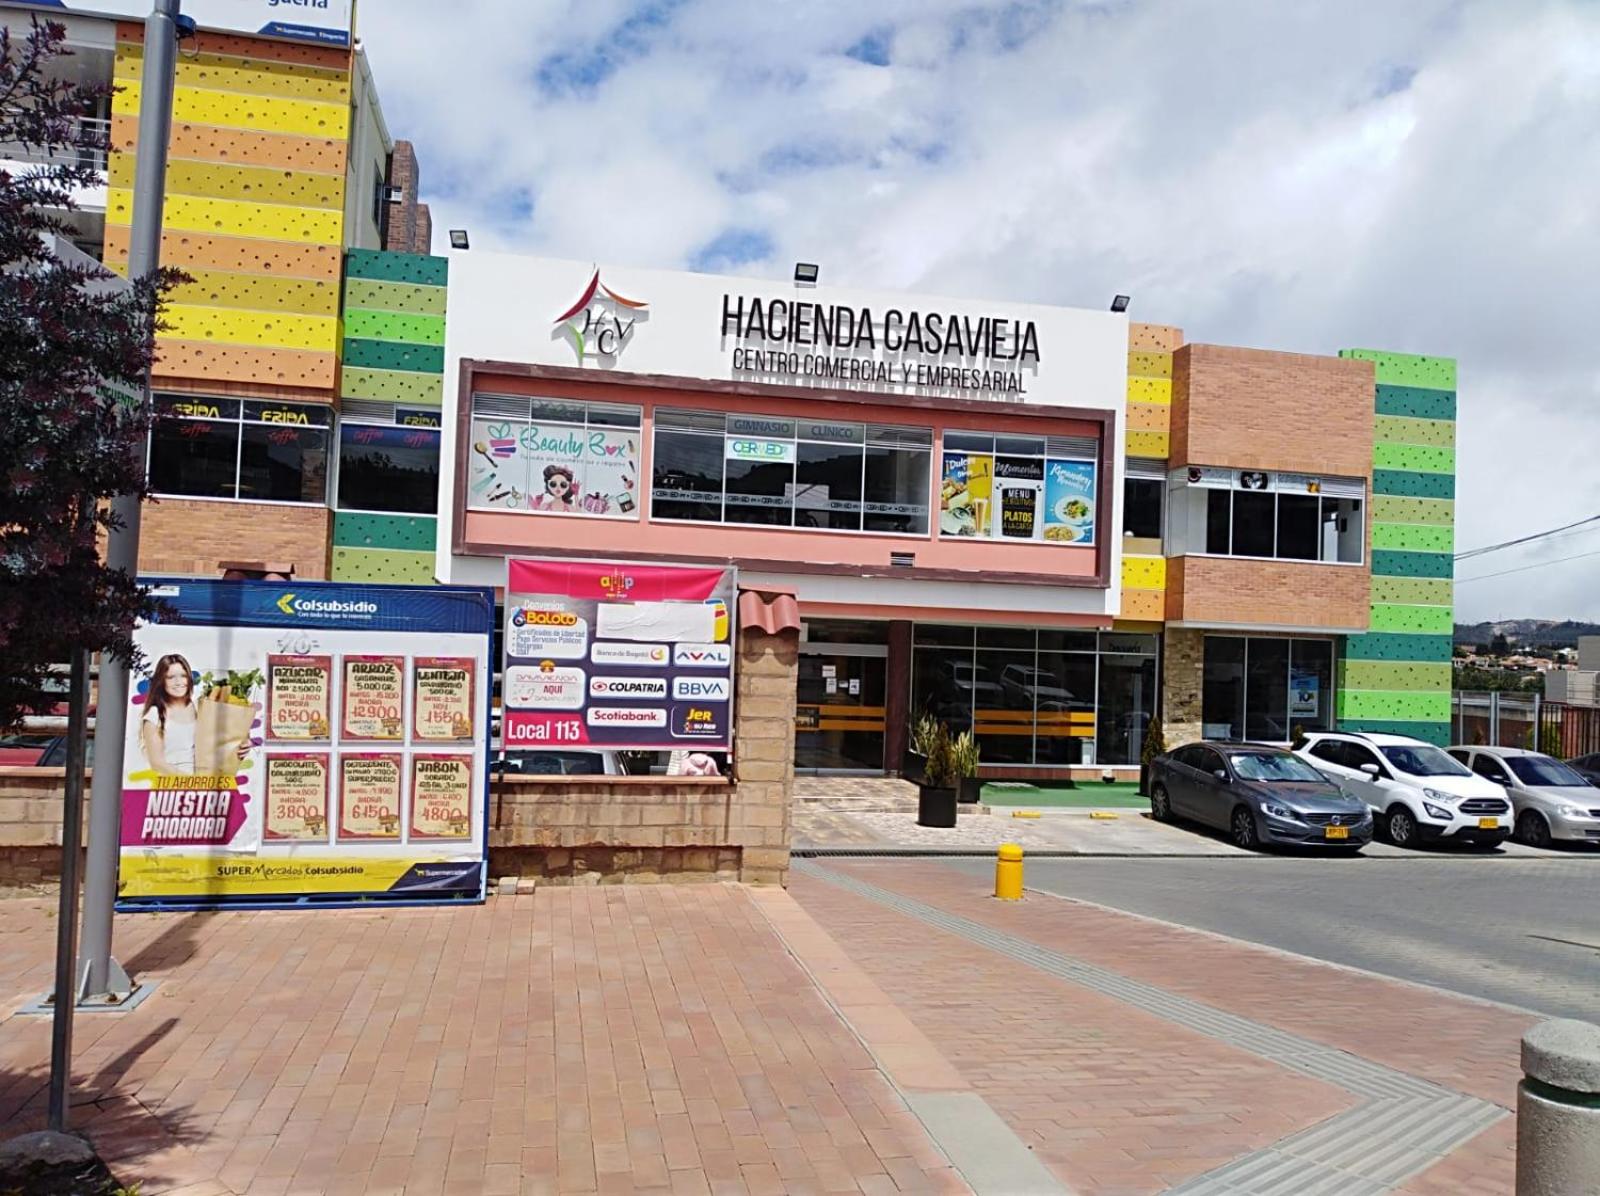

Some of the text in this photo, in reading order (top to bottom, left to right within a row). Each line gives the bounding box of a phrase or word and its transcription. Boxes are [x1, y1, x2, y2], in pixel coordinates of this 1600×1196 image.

[721, 294, 1041, 363] HACIENDA CASAVIEJA
[733, 347, 1028, 394] CENTRO COMERCIAL Y EMPRESARIAL
[261, 408, 309, 425] FRIDA
[734, 420, 790, 433] GIMNASIO
[520, 427, 584, 457] Beauty
[1004, 511, 1033, 522] PLATOS
[294, 600, 377, 612] Colsubsidio
[526, 611, 576, 625] Baloto
[677, 651, 727, 661] AVAL
[352, 663, 395, 674] ARROZ
[417, 671, 465, 681] LENTEJA
[609, 682, 664, 693] COLPATRIA
[679, 682, 723, 695] BBVA
[352, 705, 398, 718] 12900
[594, 710, 656, 721] Scotiabank
[508, 720, 580, 740] Local 113
[157, 777, 230, 788] TU AHORRO ES
[146, 791, 231, 816] NUESTRA
[277, 805, 318, 819] 3800
[352, 805, 389, 819] 6150
[422, 807, 462, 821] 4800
[141, 817, 227, 839] PRIORIDAD
[217, 864, 363, 879] SUPER Mercados Colsubsidio
